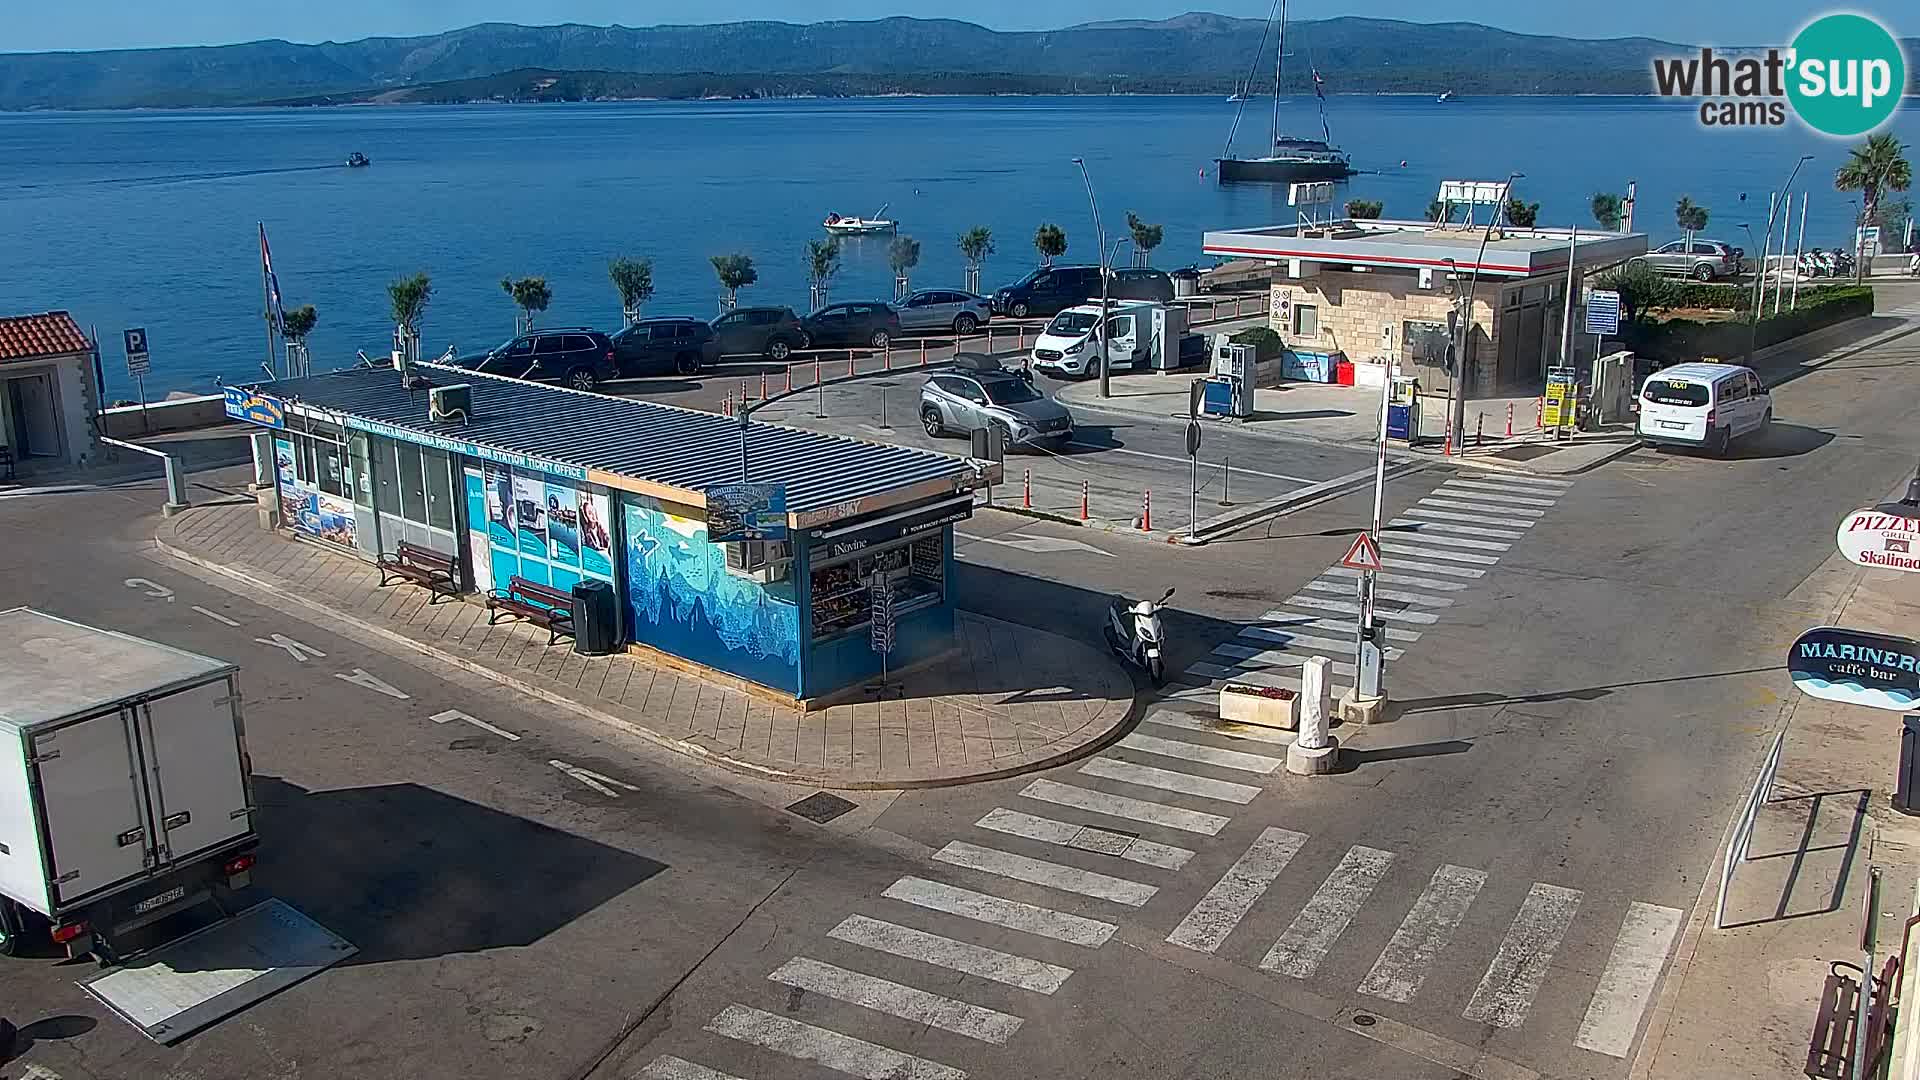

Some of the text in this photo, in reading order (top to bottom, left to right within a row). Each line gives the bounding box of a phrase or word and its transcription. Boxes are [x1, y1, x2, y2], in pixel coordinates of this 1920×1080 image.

[1669, 382, 1688, 390] TAXI
[436, 438, 467, 453] POSTAJA
[478, 447, 581, 478] BUS STATION TICKET OFFICE
[949, 511, 967, 521] CHOICE
[1881, 531, 1916, 541] GRILL
[1828, 662, 1897, 681] caffe bar
